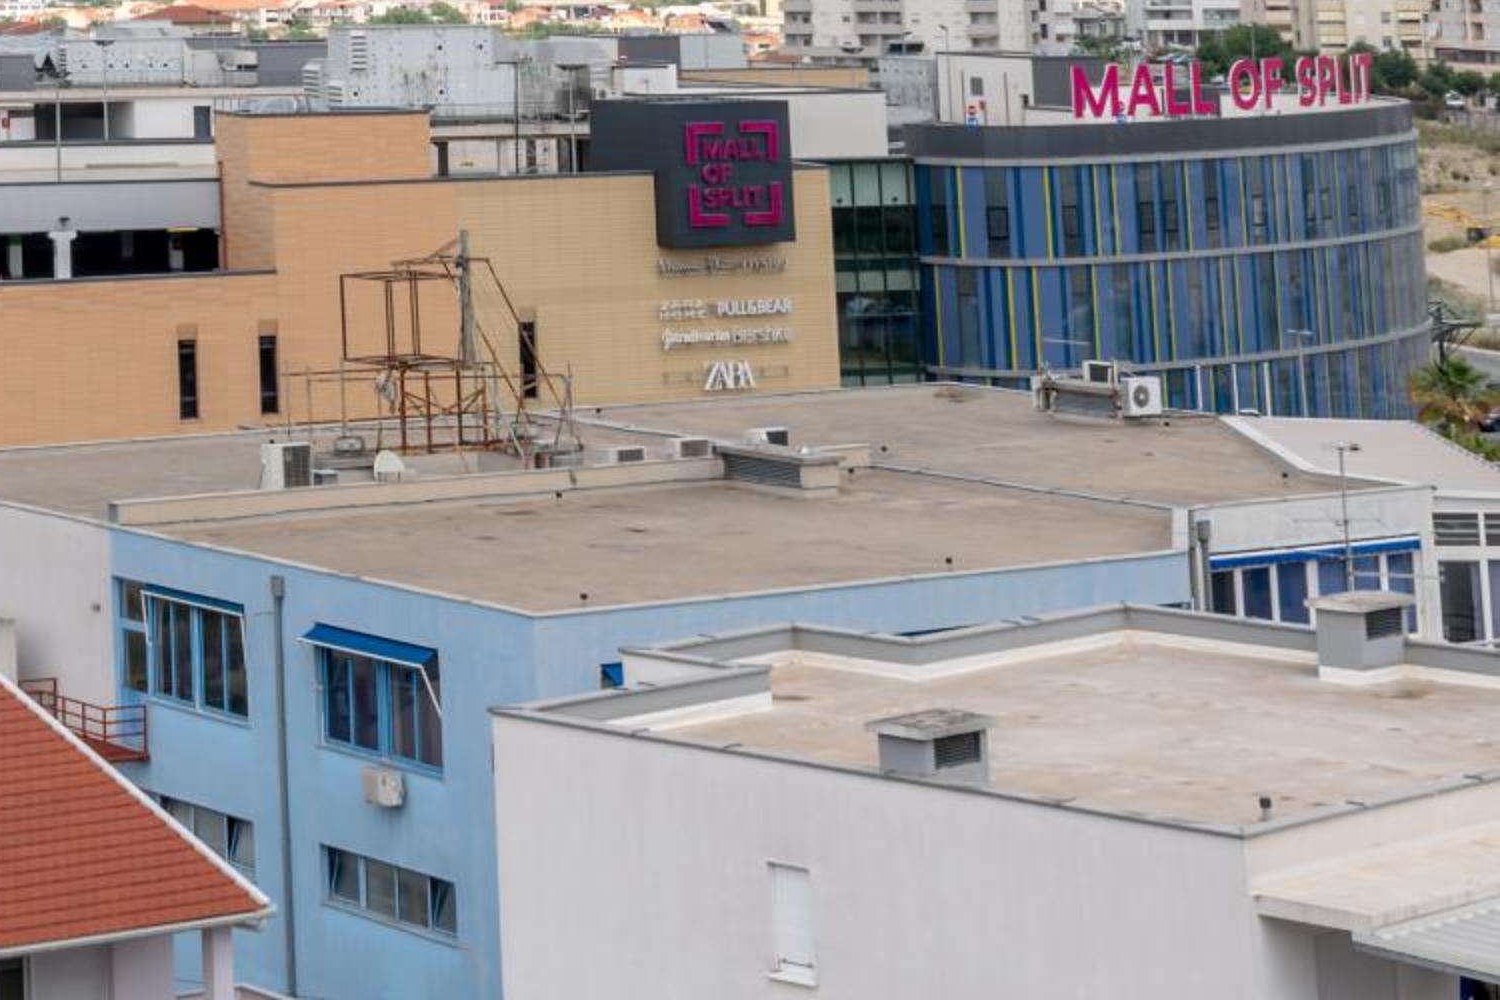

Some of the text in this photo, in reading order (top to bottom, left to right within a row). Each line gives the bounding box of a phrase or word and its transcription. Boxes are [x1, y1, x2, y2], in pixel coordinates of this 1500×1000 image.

[1070, 54, 1373, 119] MALL OF SPLIT
[702, 137, 768, 160] MALL
[702, 162, 733, 184] OF
[703, 184, 766, 208] SPLIT
